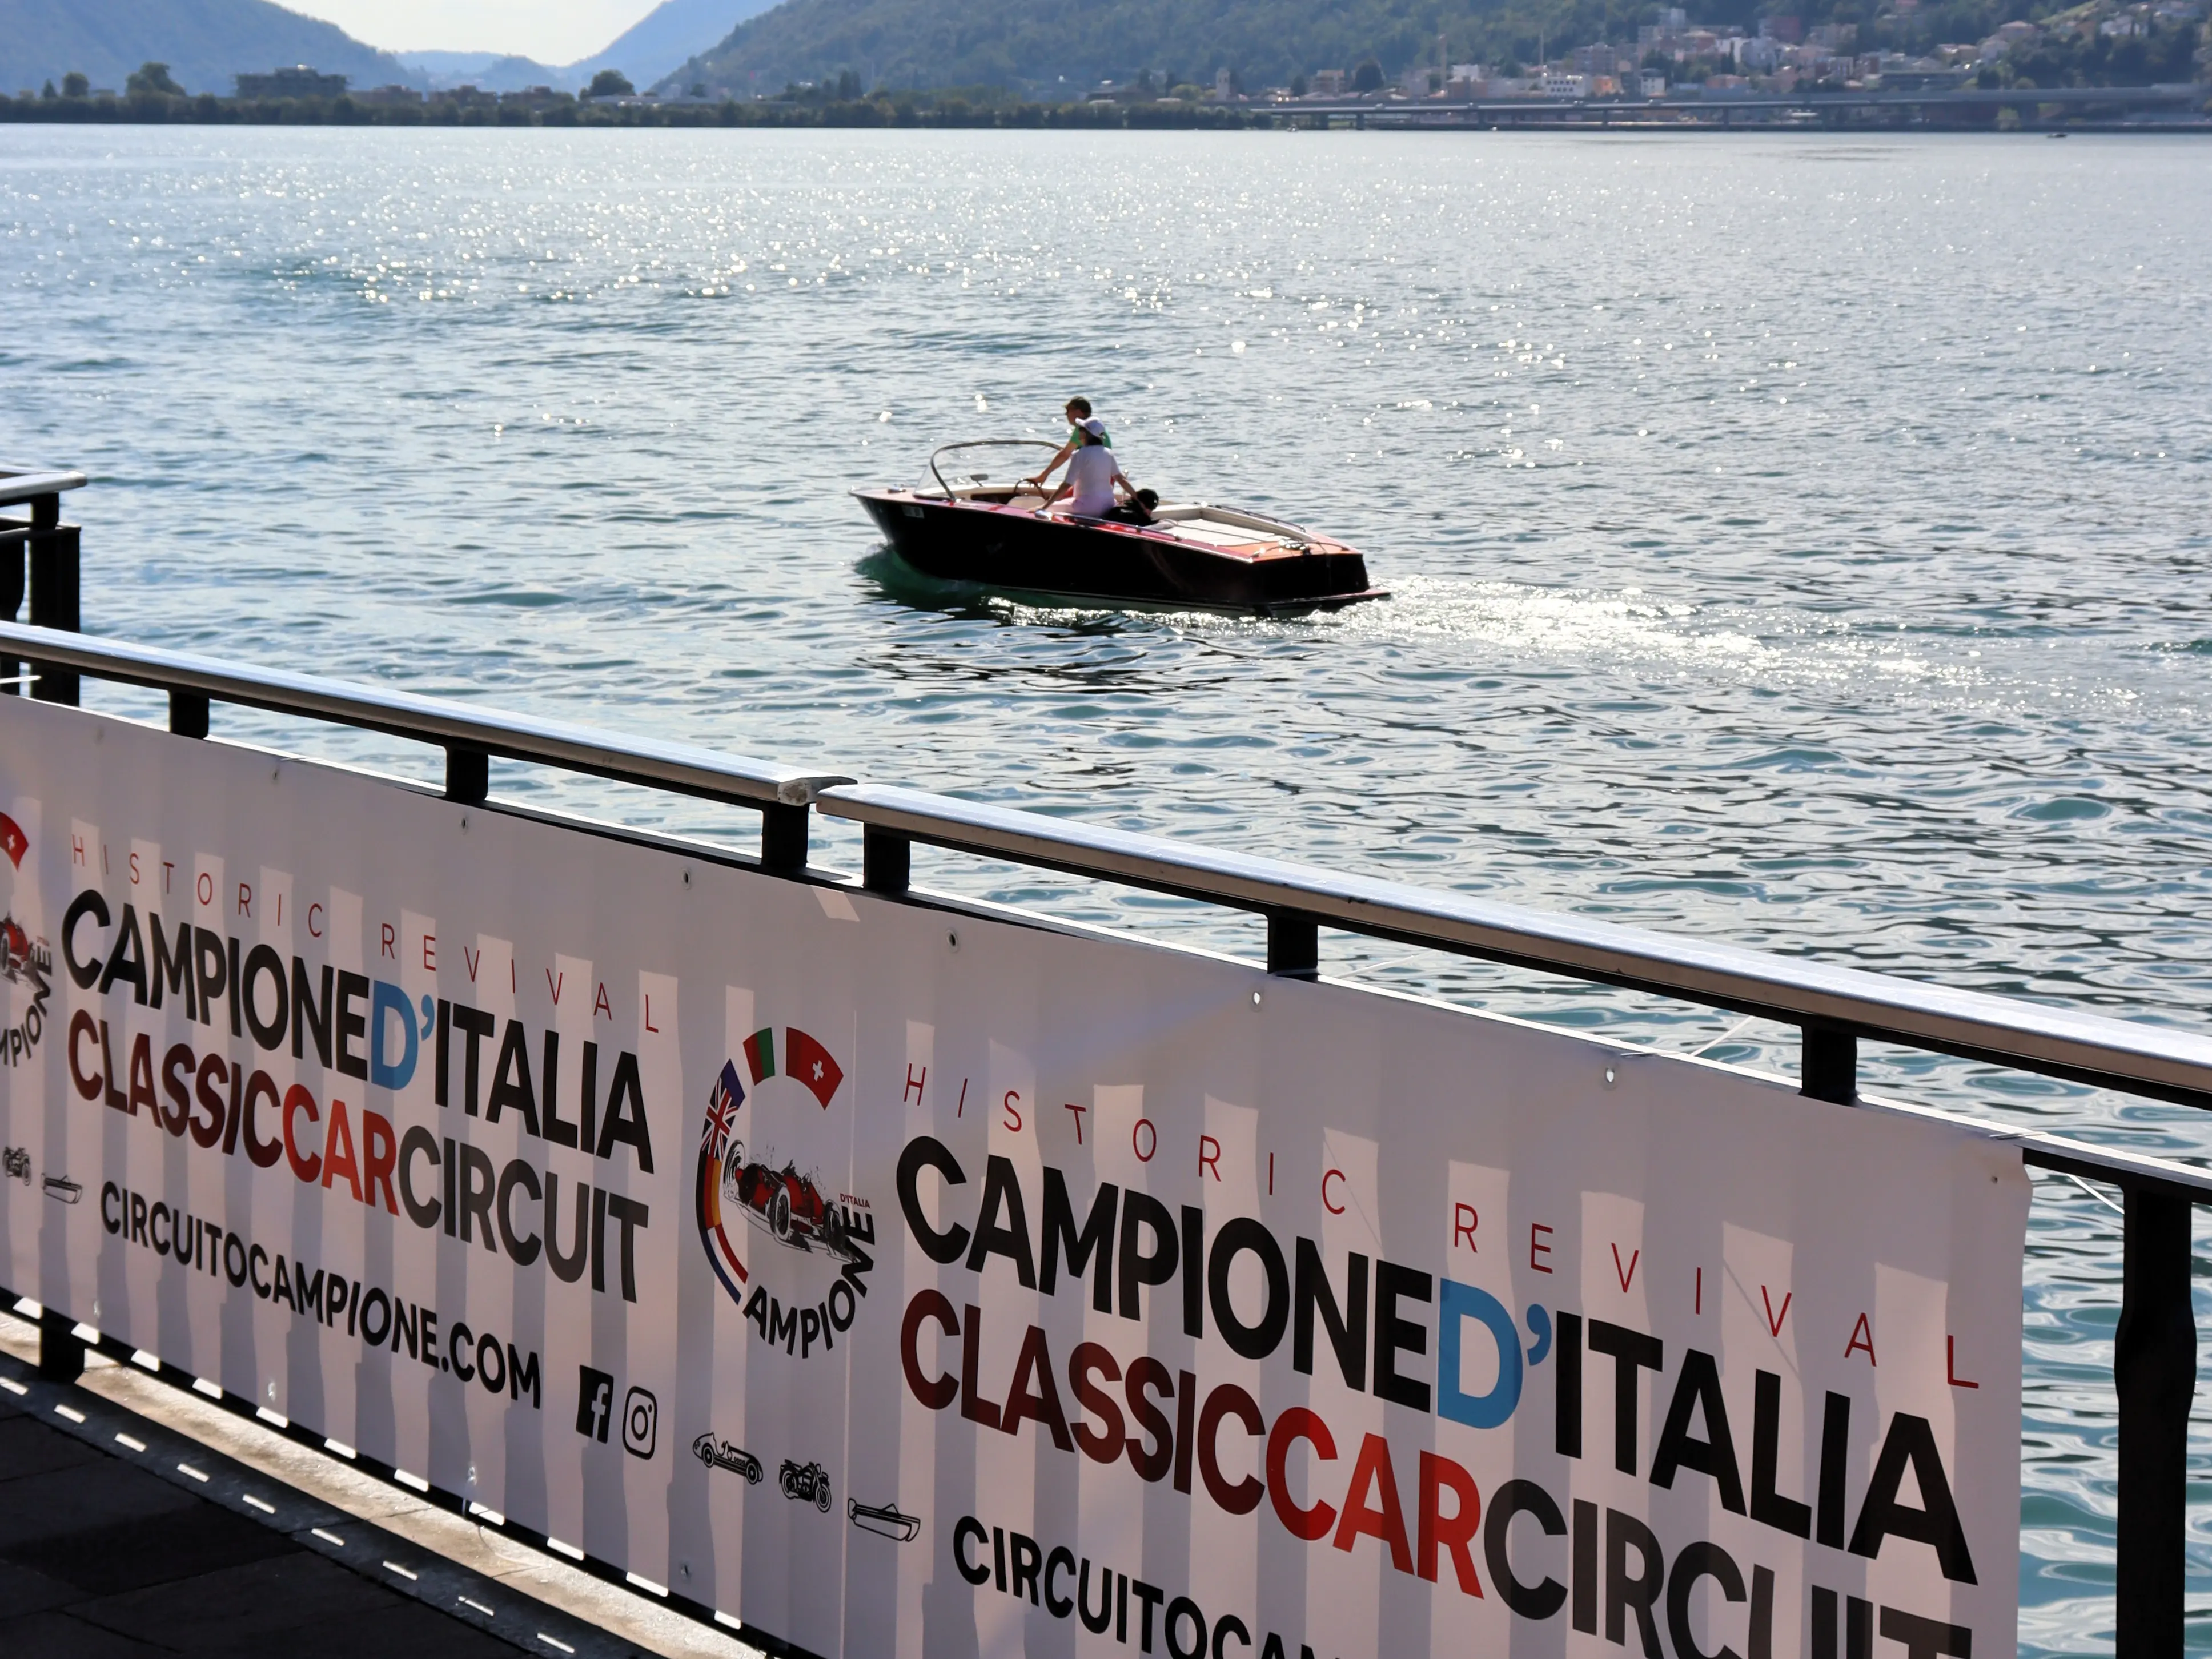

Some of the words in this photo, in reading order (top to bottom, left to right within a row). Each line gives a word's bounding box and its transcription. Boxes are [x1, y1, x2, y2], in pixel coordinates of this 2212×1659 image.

[71, 834, 323, 937] HISTORIC
[381, 923, 659, 1033] REVIVAL
[67, 1009, 649, 1303] CLASSICCARCIRCUIT
[840, 1193, 871, 1209] D'ITALIA
[904, 1063, 1347, 1215] HISTORIC
[1454, 1202, 1980, 1389] REVIVAL
[100, 1180, 541, 1410] CIRCUITOCAMPIONE.COM
